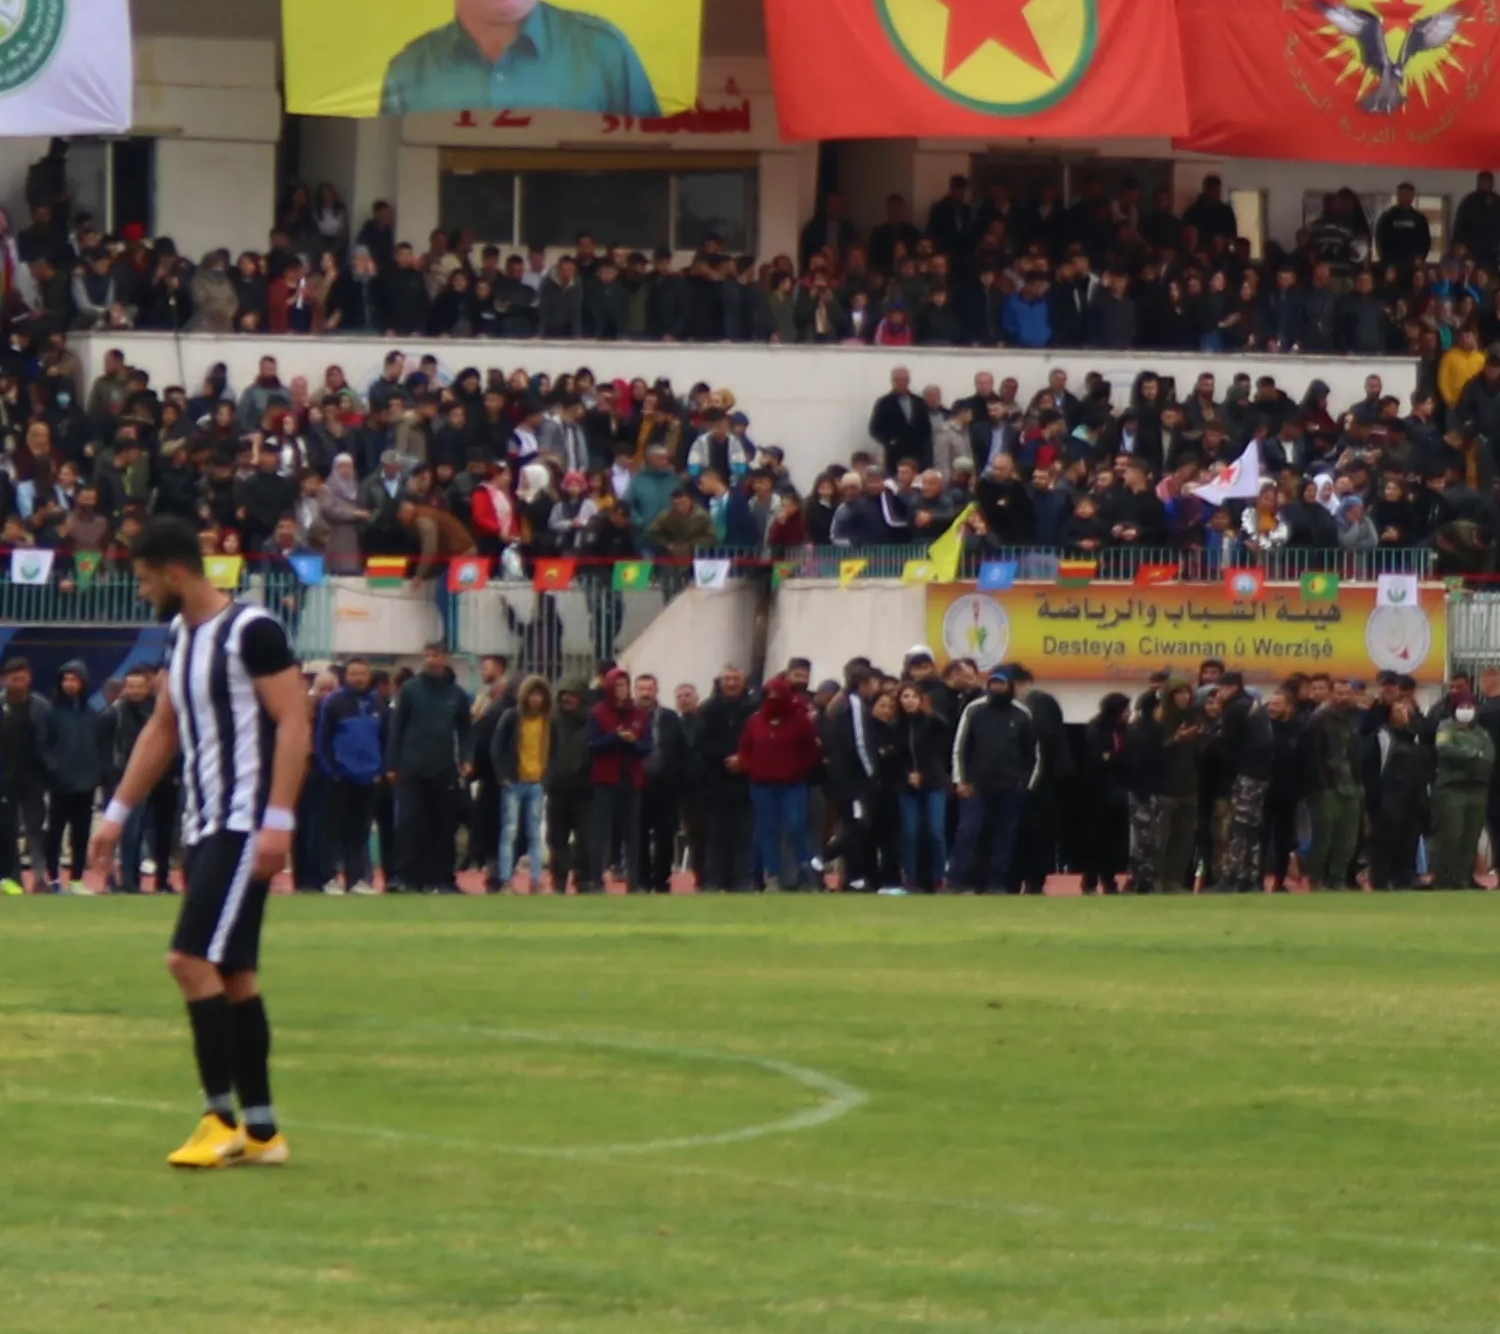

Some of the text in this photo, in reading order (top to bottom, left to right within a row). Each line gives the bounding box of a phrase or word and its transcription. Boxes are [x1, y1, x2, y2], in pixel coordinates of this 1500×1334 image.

[1035, 590, 1158, 630] والرياضة
[1042, 635, 1126, 660] Desteya
[1138, 635, 1226, 656] Ciwanan
